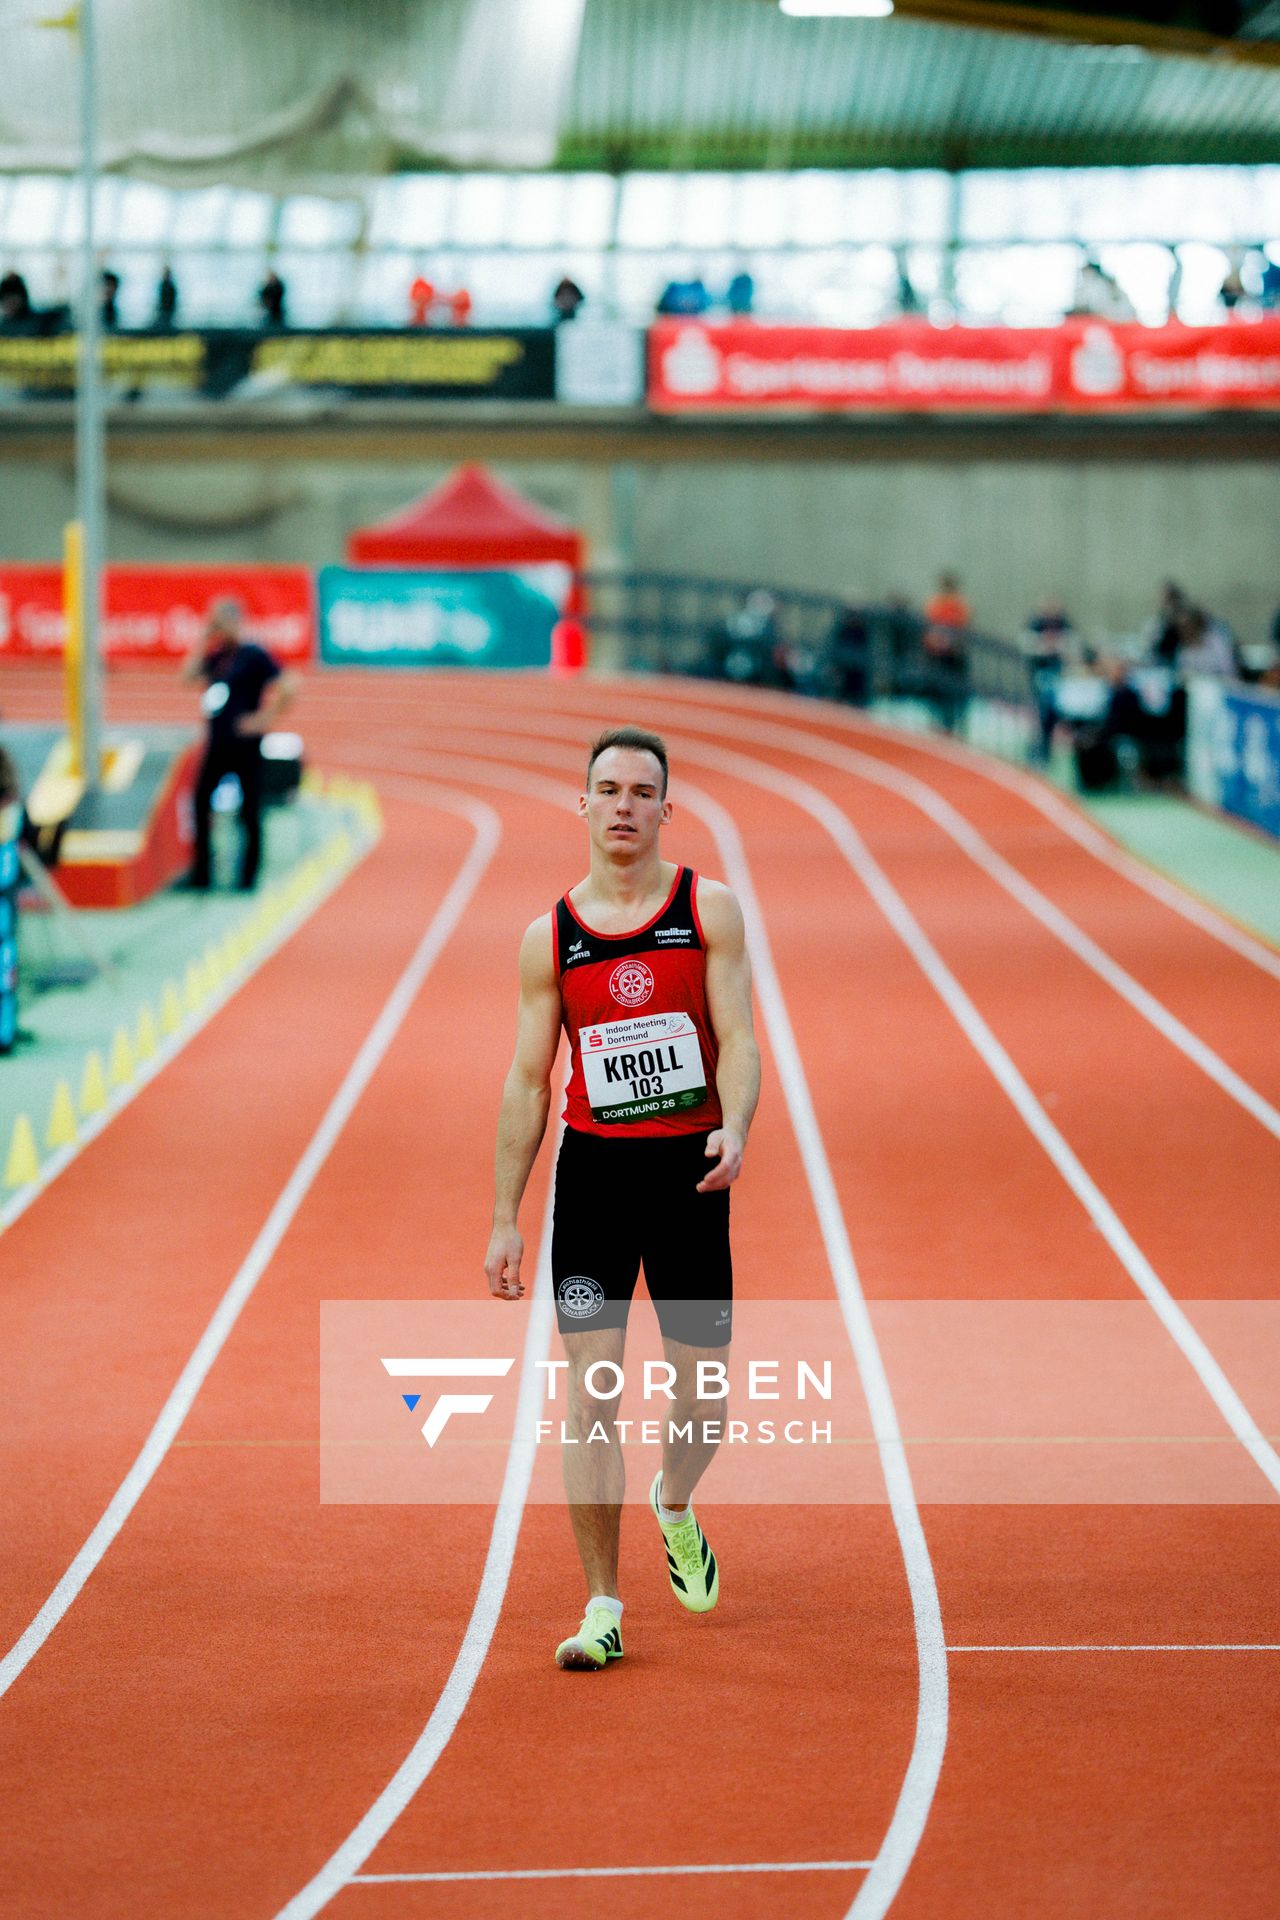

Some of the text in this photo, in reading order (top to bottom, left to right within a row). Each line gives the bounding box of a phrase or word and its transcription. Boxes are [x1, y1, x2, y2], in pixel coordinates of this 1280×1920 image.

[611, 984, 619, 993] L
[644, 977, 652, 987] G
[605, 1018, 667, 1035] Indoor Meeting
[607, 1031, 649, 1045] Dortmund
[603, 1045, 684, 1083] KROLL
[629, 1075, 664, 1099] 103
[602, 1102, 660, 1119] DORTMUND
[661, 1099, 676, 1109] 26
